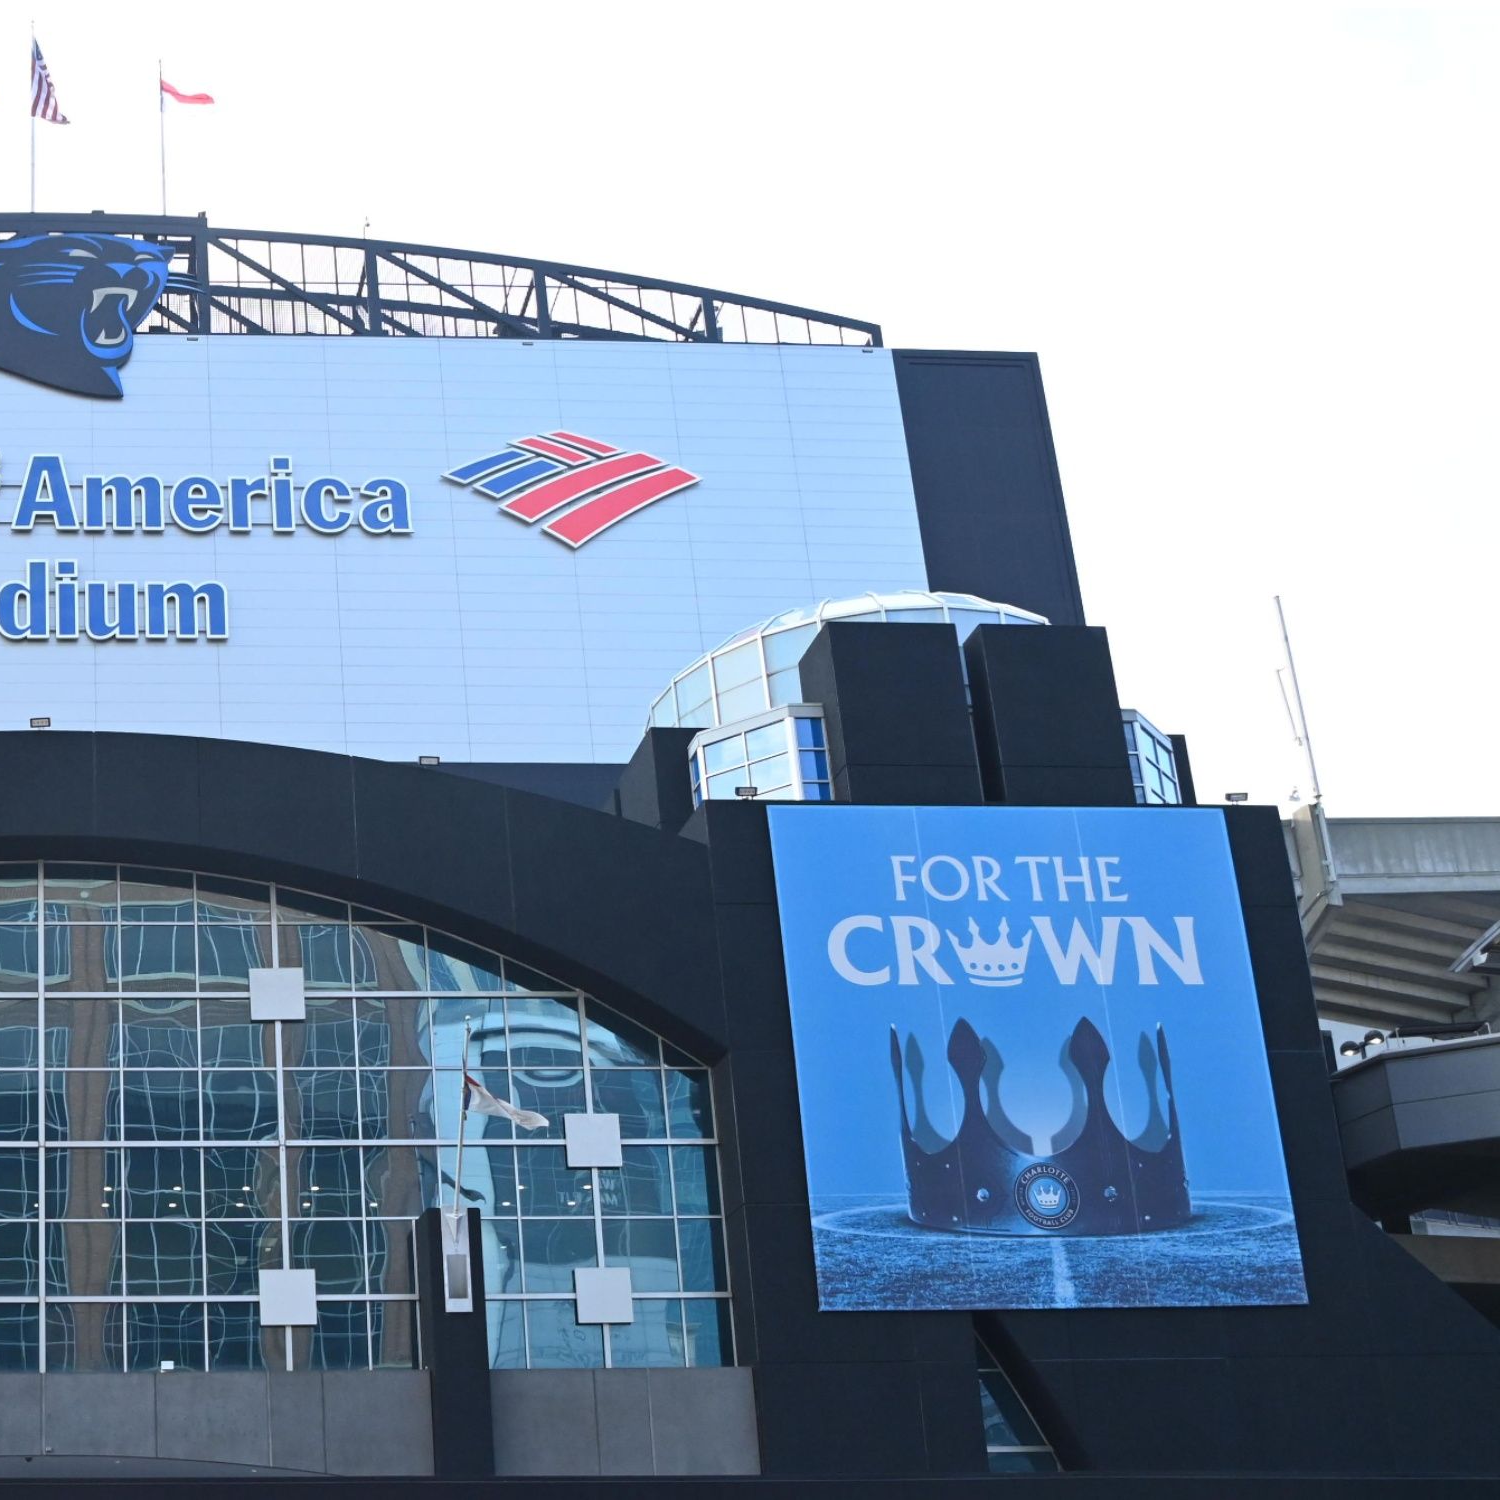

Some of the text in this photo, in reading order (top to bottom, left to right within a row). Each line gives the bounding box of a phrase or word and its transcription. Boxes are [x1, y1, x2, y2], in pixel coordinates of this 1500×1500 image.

[11, 453, 414, 533] America
[890, 855, 1128, 902] FOR THE
[827, 914, 1204, 986] CRWN
[1021, 1166, 1068, 1184] CHARLOTTE
[1026, 1209, 1059, 1226] FOOTBALL
